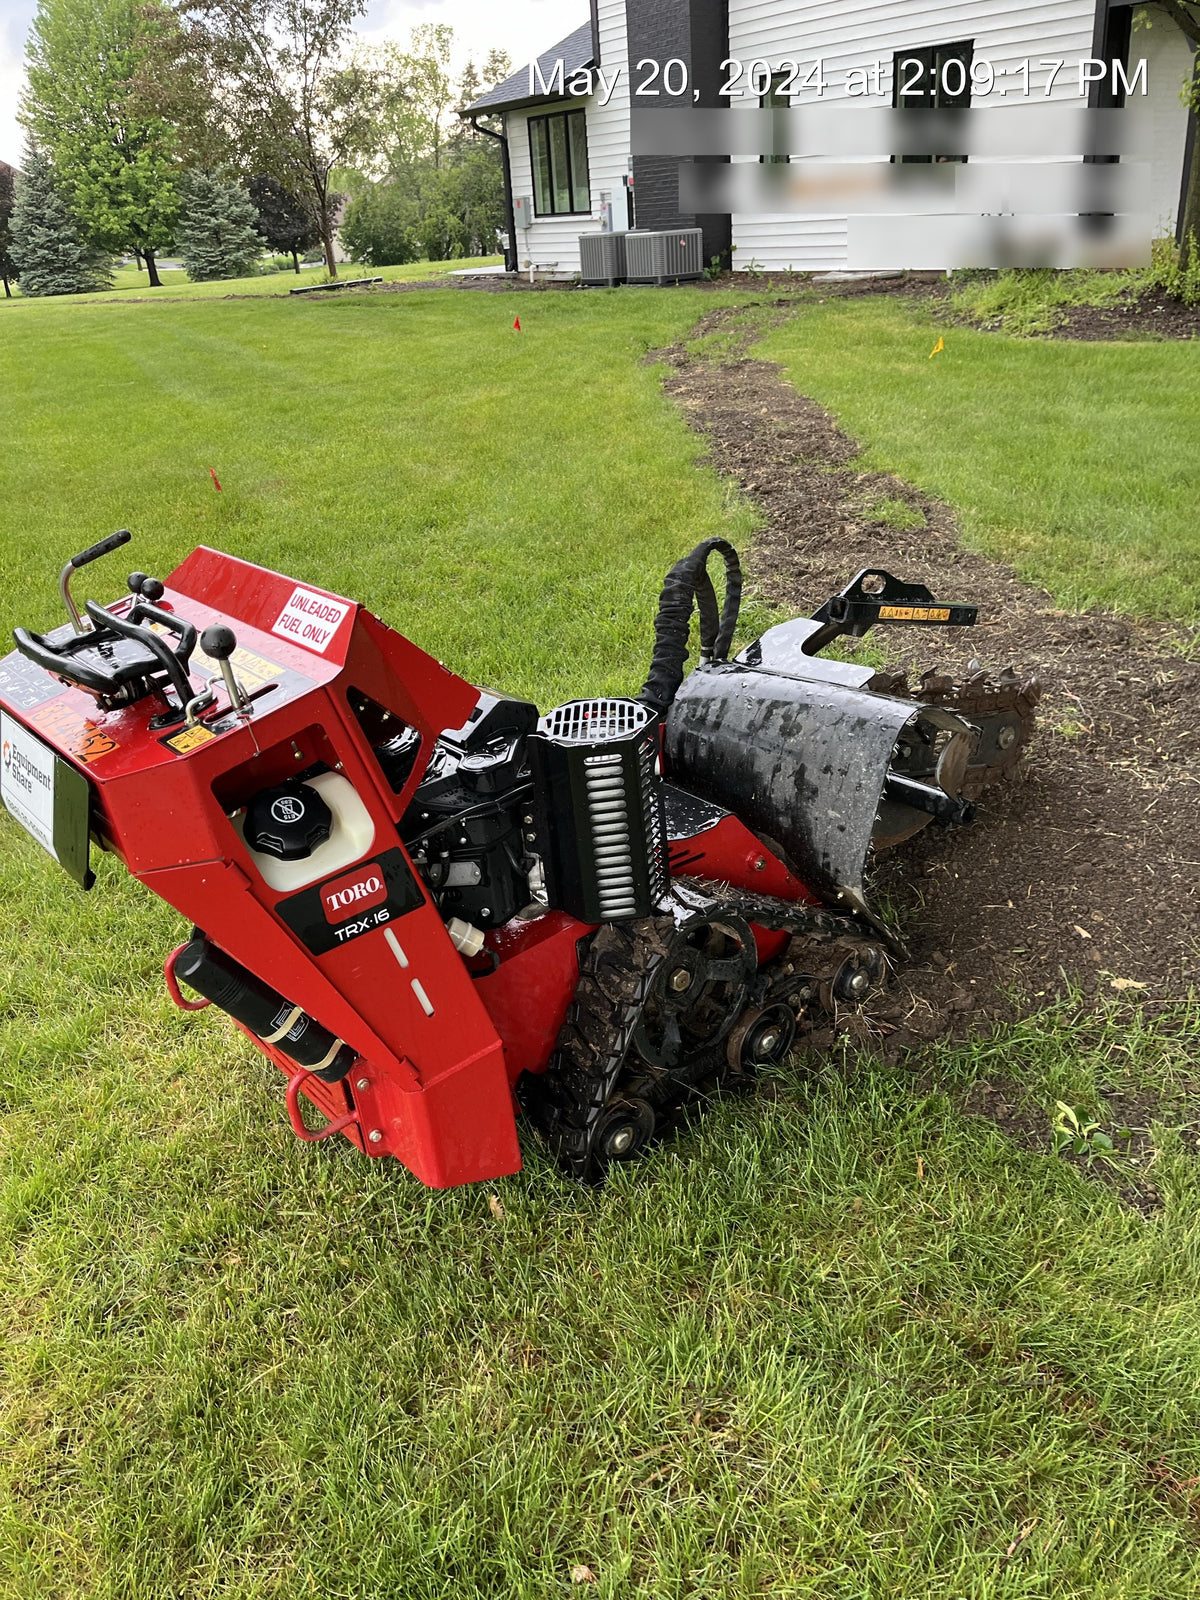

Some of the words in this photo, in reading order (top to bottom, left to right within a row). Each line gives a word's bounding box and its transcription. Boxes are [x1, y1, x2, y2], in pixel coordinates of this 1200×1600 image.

[290, 594, 342, 624] UNLEADED
[278, 613, 302, 634] FUEL
[302, 624, 331, 645] ONLY
[12, 743, 51, 792] Equipment
[12, 763, 32, 794] Share
[326, 876, 381, 912] TORO
